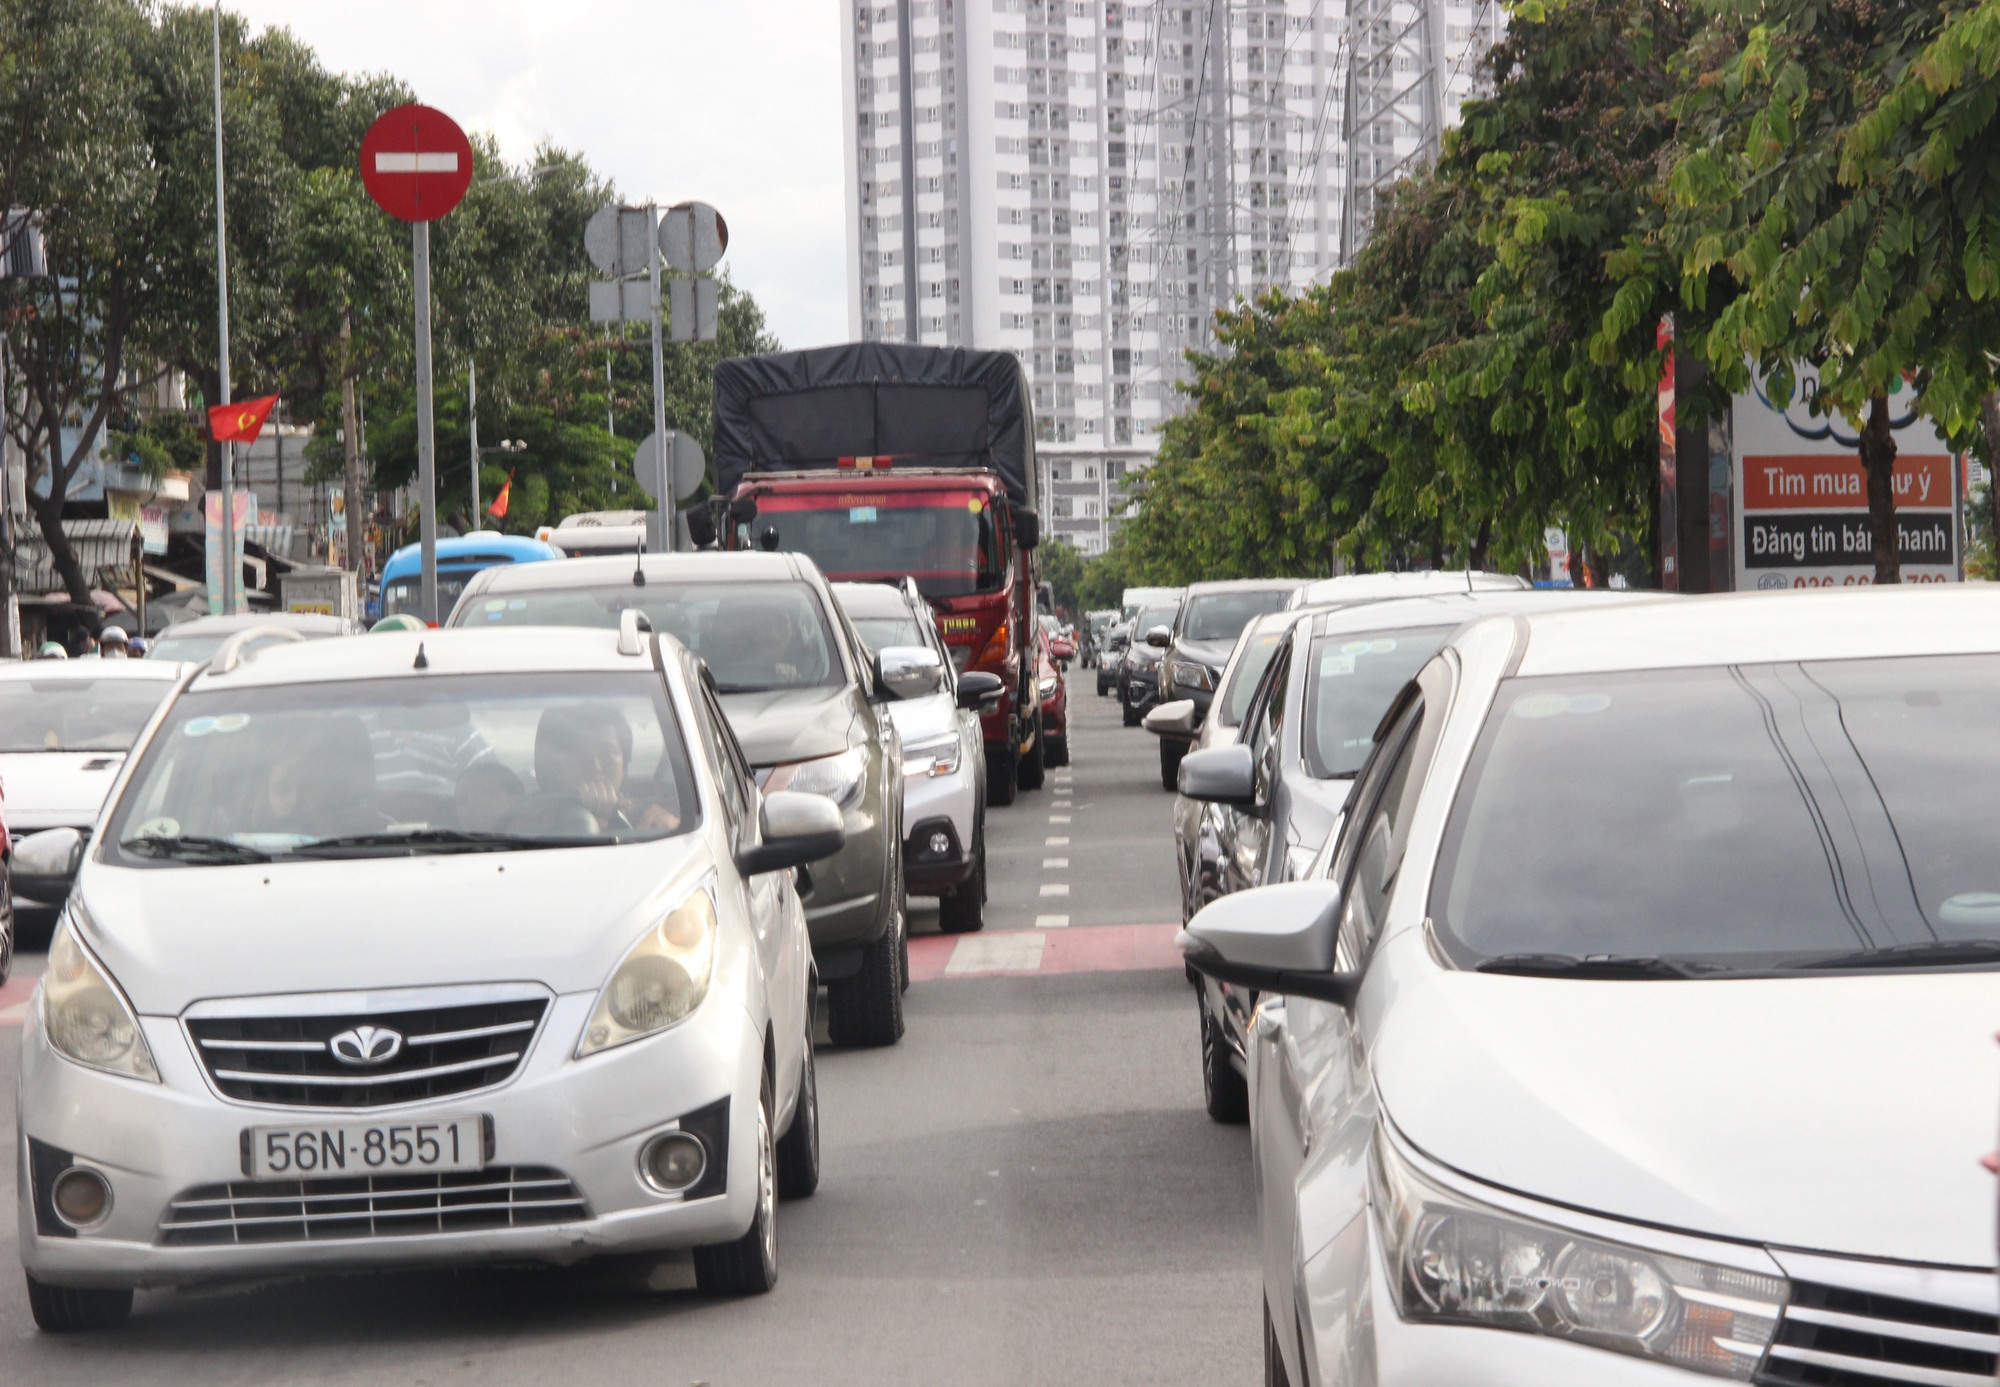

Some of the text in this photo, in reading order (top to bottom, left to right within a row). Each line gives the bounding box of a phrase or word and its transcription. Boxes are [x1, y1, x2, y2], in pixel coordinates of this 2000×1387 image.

[1763, 467, 1806, 496] Tìm
[1813, 472, 1861, 496] mua
[1919, 466, 1931, 501] ý
[1752, 524, 1806, 562] Đăng
[1811, 524, 1836, 553] tin
[1898, 523, 1946, 551] hanh
[266, 1121, 459, 1172] 56N-8551
